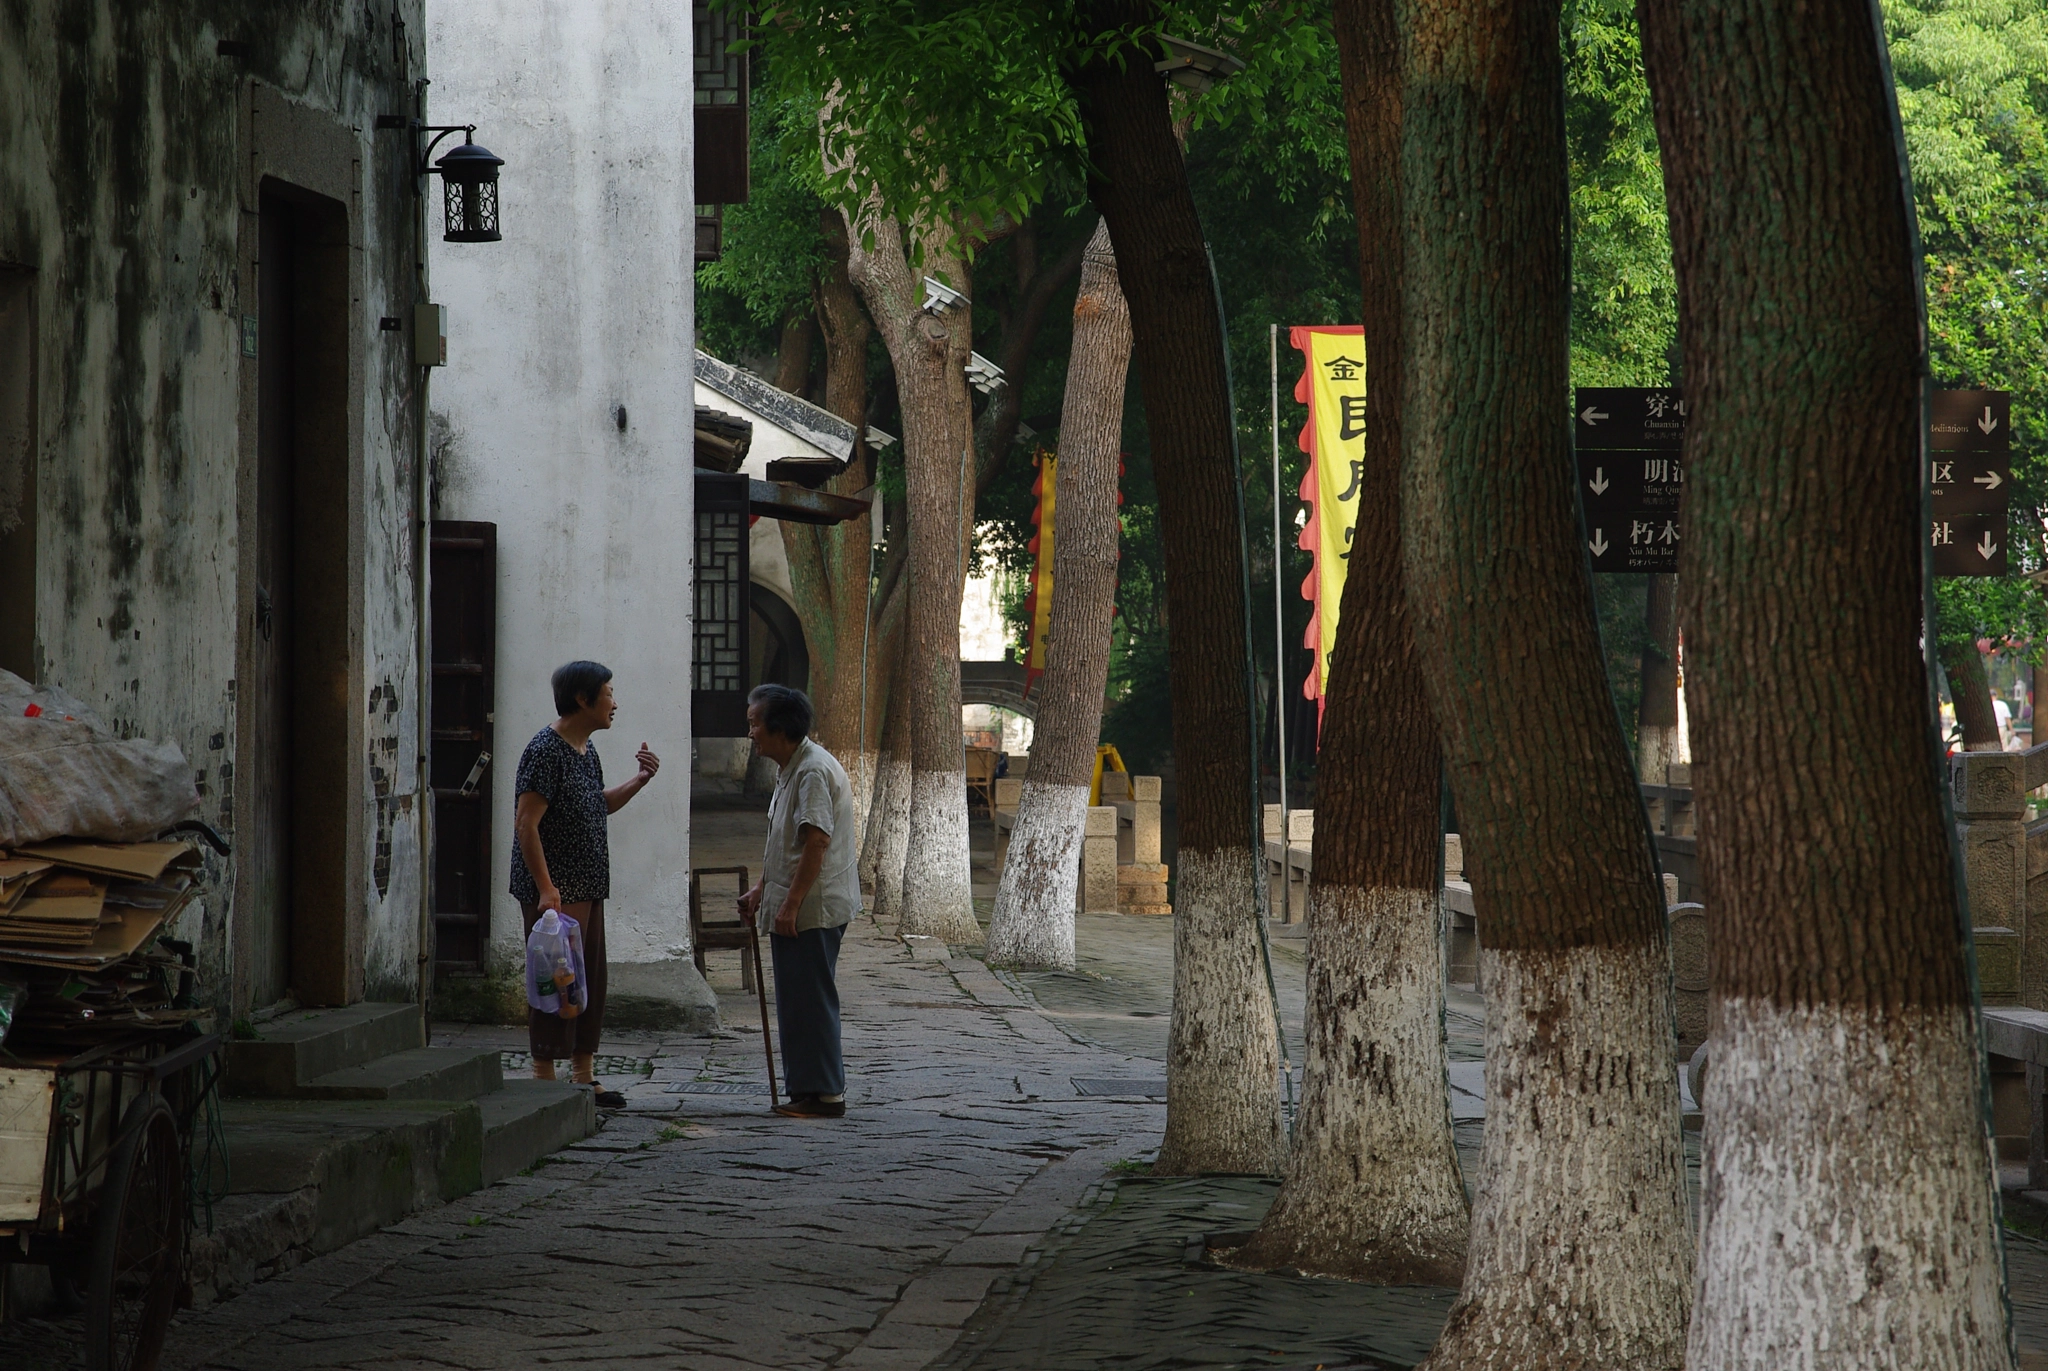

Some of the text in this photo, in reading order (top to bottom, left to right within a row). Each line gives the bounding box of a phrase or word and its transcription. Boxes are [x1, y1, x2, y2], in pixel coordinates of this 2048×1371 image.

[1324, 355, 1364, 381] 金
[1644, 419, 1679, 429] Chuanxin
[1931, 460, 1955, 484] 区
[1643, 485, 1662, 496] Ming
[1629, 519, 1681, 545] 朽木
[1931, 521, 1955, 547] 社
[1628, 547, 1674, 556] Xiu Mu Bar
